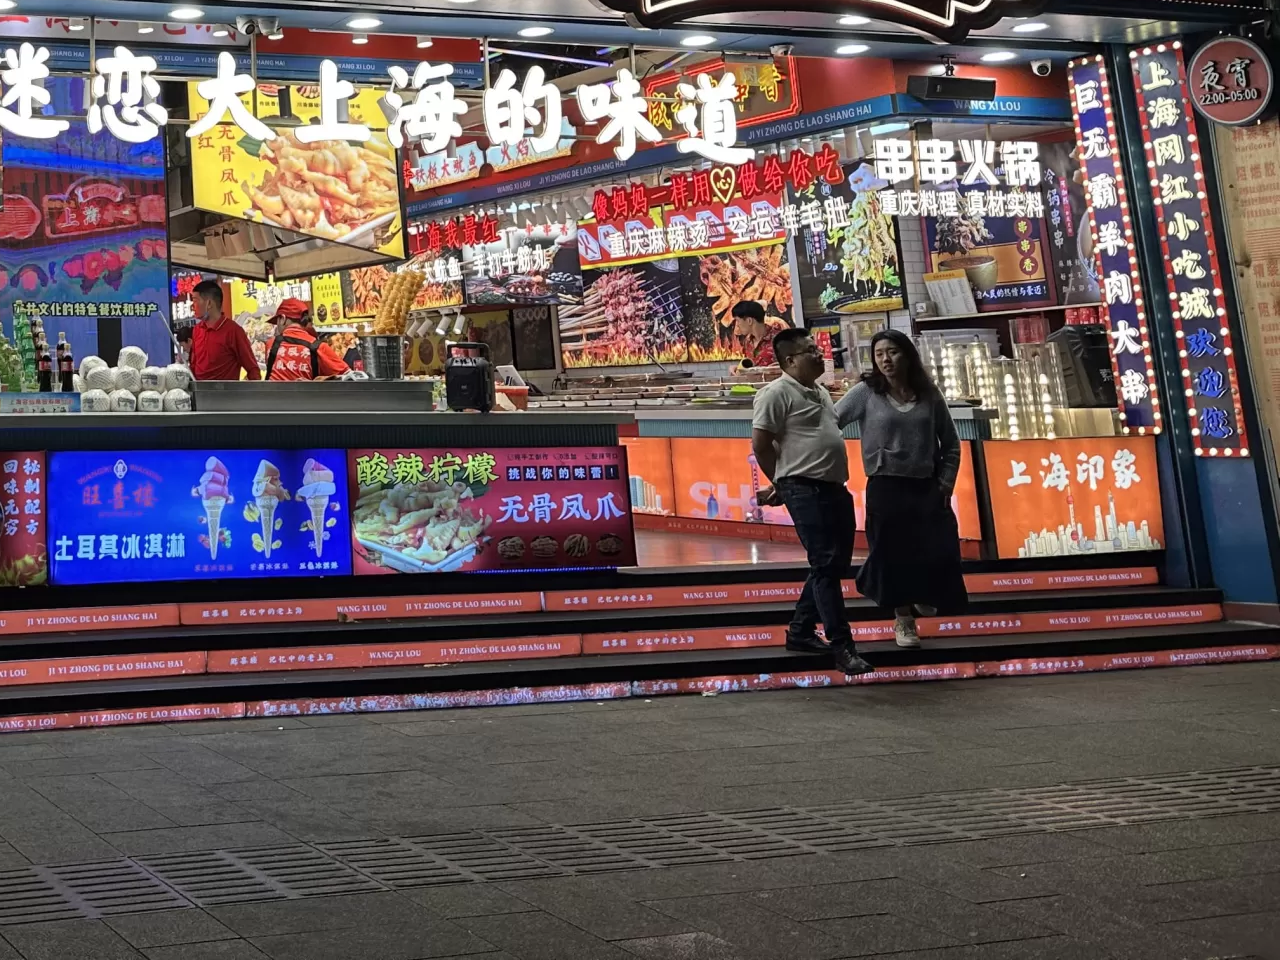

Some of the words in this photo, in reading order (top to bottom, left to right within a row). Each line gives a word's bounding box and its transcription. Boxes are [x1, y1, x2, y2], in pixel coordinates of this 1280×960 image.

[1200, 57, 1252, 92] 夜宵
[953, 99, 986, 111] WANG
[987, 100, 999, 111] XI
[1000, 100, 1021, 111] LOU
[1199, 89, 1258, 106] 22:00-05:00
[747, 126, 756, 140] JI
[756, 125, 765, 137] YI
[764, 118, 793, 136] ZHONG
[793, 117, 805, 130] DE
[806, 114, 823, 128] LAO
[823, 108, 855, 124] SHANG
[856, 103, 872, 117] HAI
[217, 124, 239, 208] 无骨凤爪
[873, 138, 1042, 187] 串串火锅
[880, 189, 960, 218] 重庆料理
[967, 191, 1045, 218] 真材实料
[410, 214, 501, 257] 上海我最红
[609, 221, 710, 259] 重庆麻辣烫
[1016, 220, 1036, 272] 串串香
[1074, 81, 1149, 406] 巨无霸羊肉大串
[1143, 60, 1234, 438] 上海网红小吃城欢迎您
[356, 451, 500, 487] 酸辣柠檬
[1007, 448, 1142, 492] 上海印象
[3, 458, 20, 537] 回味无穷
[23, 457, 41, 537] 秘制配方
[496, 491, 626, 524] 无骨凤爪
[55, 532, 186, 561] 土耳其冰淇淋
